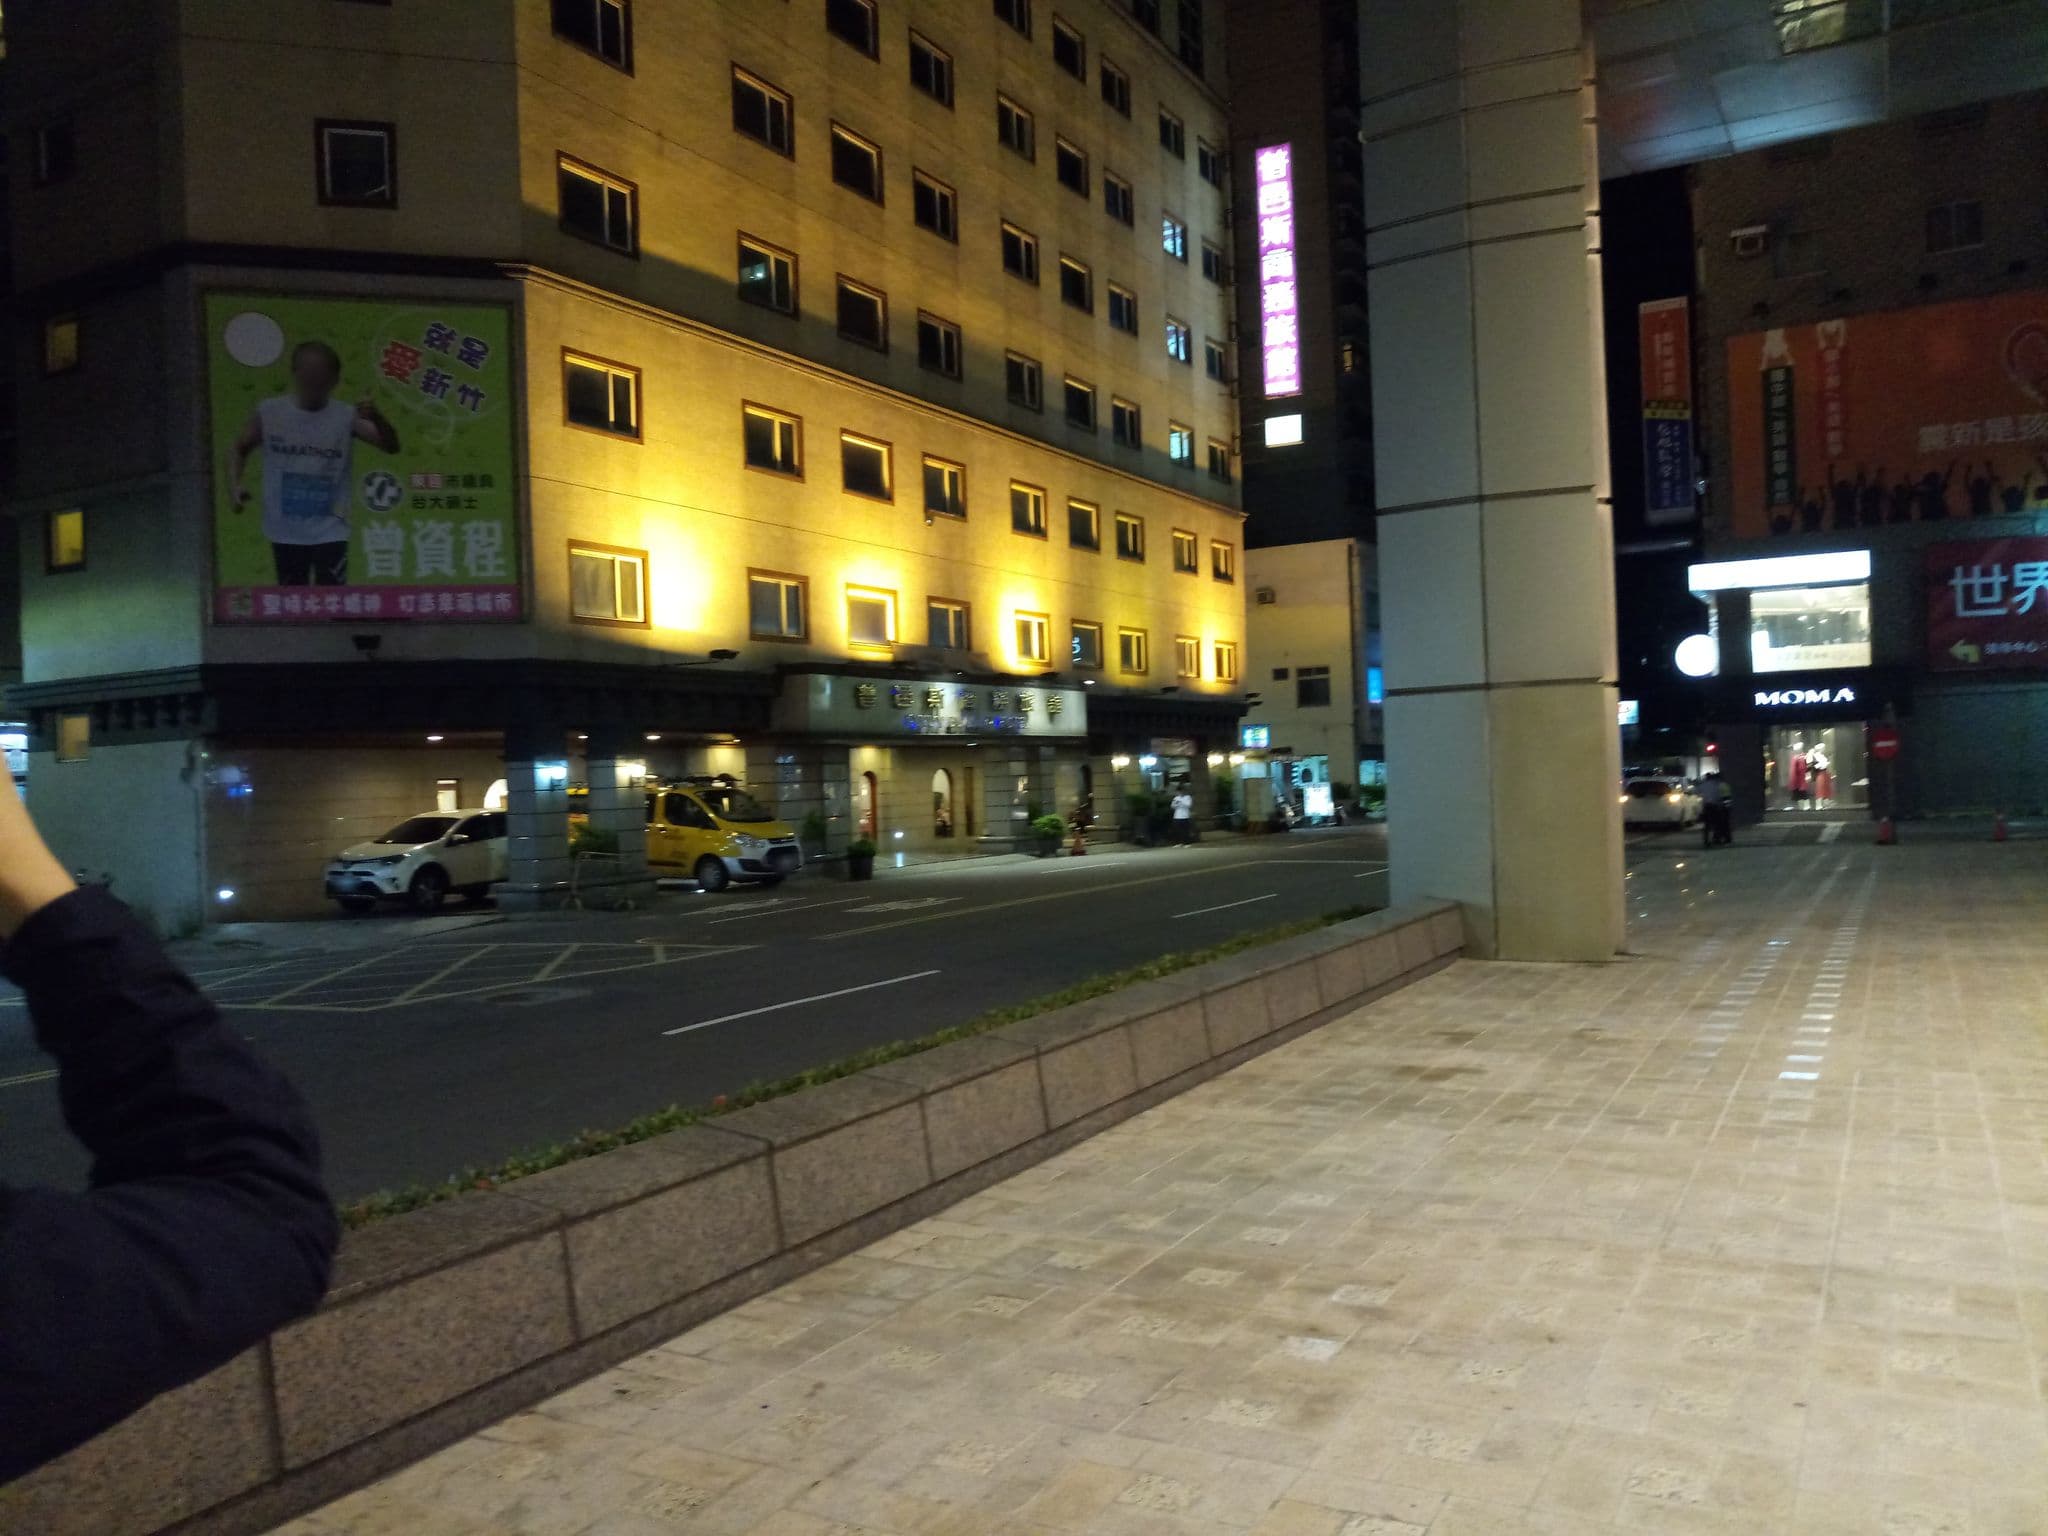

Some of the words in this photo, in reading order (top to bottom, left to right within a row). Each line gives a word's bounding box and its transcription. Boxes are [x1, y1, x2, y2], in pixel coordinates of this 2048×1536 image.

[423, 321, 490, 370] 就是
[361, 519, 507, 578] 曾資程
[1754, 687, 1855, 706] MOMA
